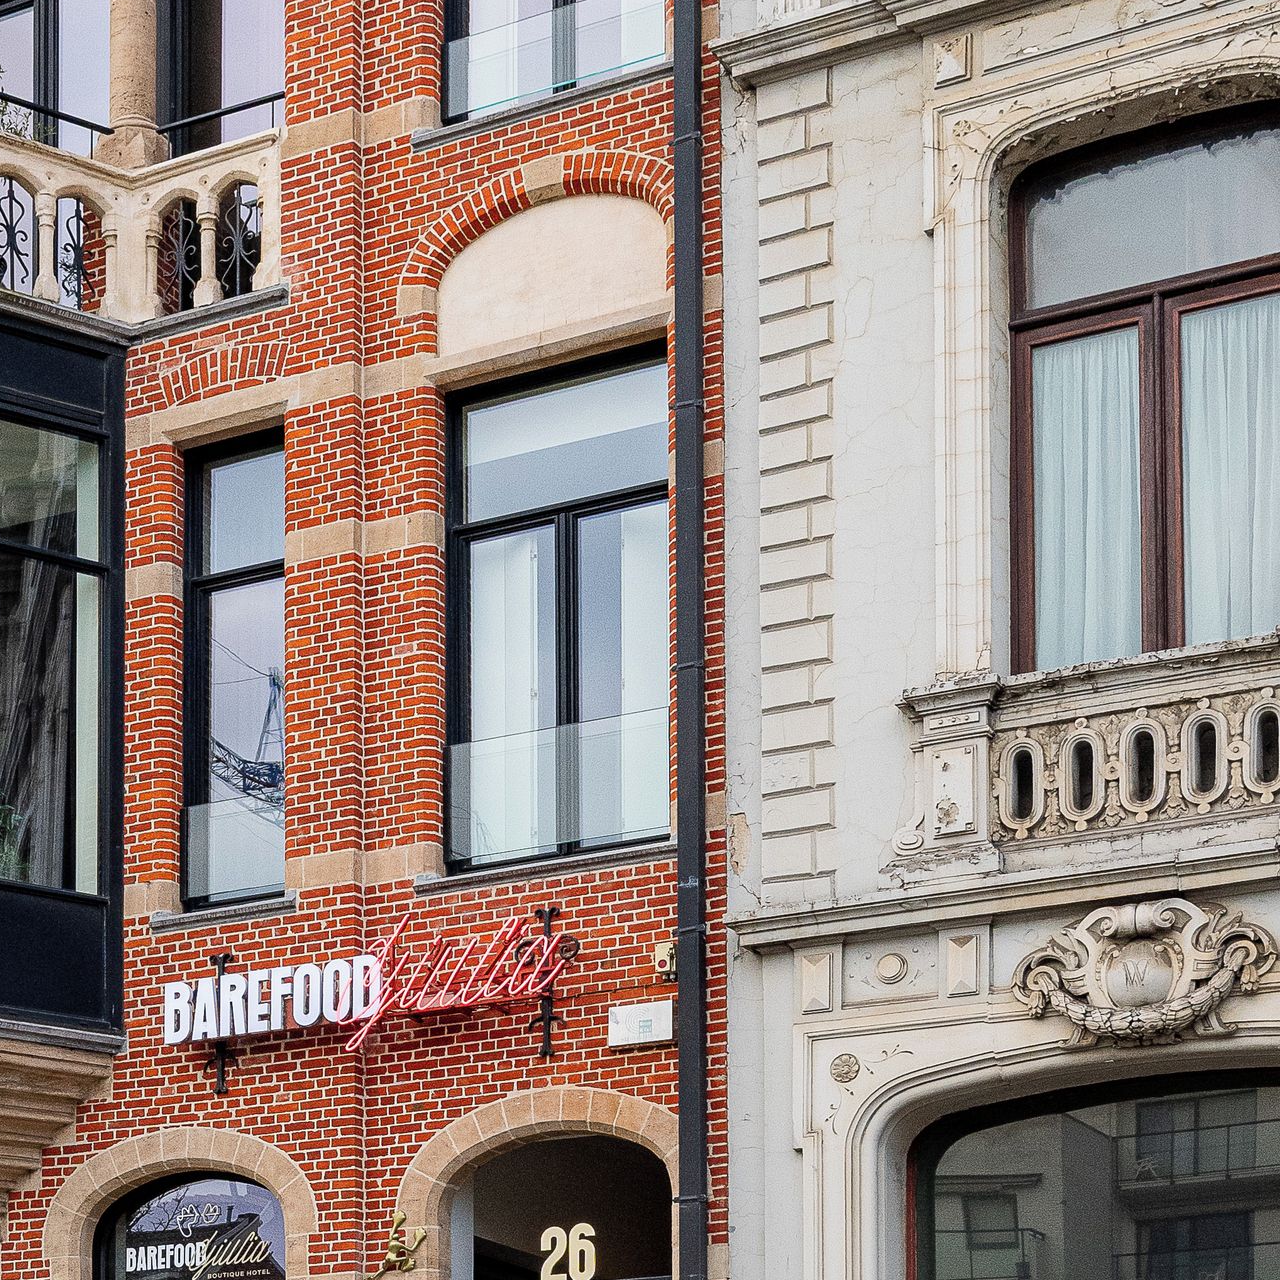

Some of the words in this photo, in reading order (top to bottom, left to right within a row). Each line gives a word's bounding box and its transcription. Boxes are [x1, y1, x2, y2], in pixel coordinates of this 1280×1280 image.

[164, 954, 381, 1046] BAREFOOD
[126, 1241, 206, 1272] BAREFOOD
[207, 1271, 245, 1280] BOUTIQUE
[246, 1269, 271, 1277] HOTEL
